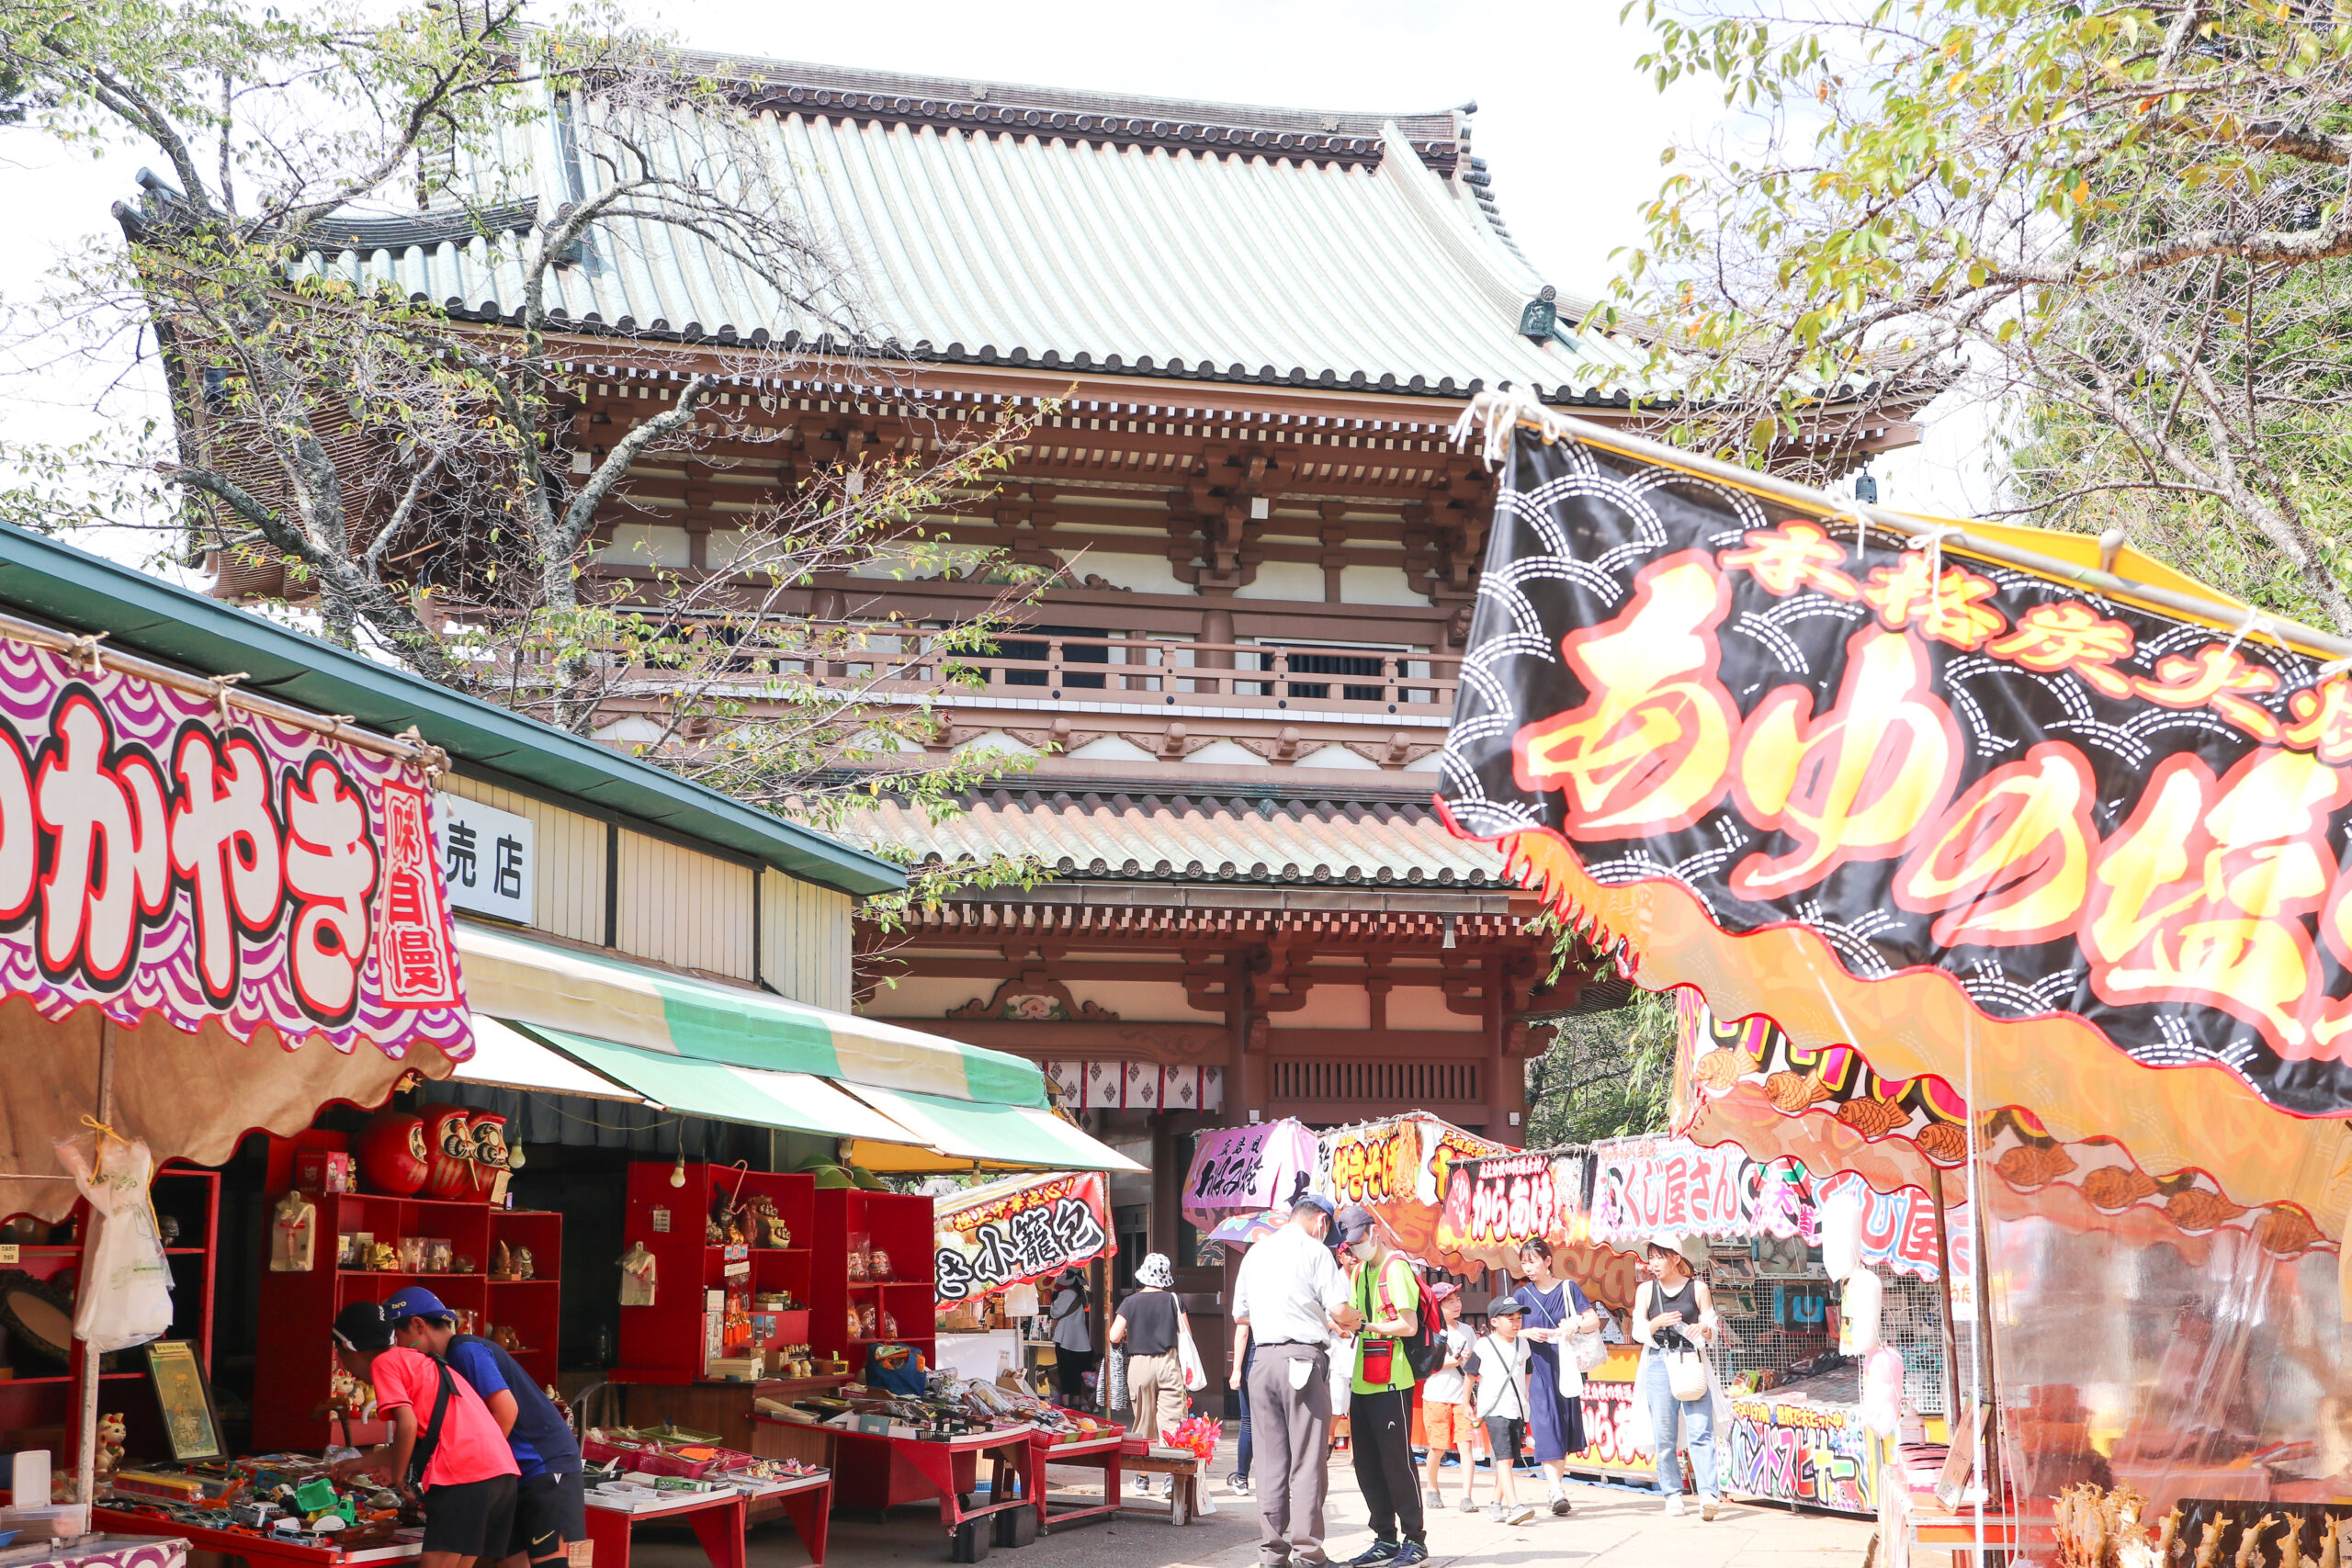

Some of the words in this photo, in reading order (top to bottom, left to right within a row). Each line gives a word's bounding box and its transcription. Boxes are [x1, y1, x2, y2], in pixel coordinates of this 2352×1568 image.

[1513, 548, 2352, 1058] あゆの塩
[390, 799, 441, 992] 味自慢
[447, 820, 523, 900] 売店
[1331, 1136, 1400, 1203] やきそば
[1623, 1154, 1737, 1227] くじ屋さん
[935, 1197, 1106, 1304] き小籠包
